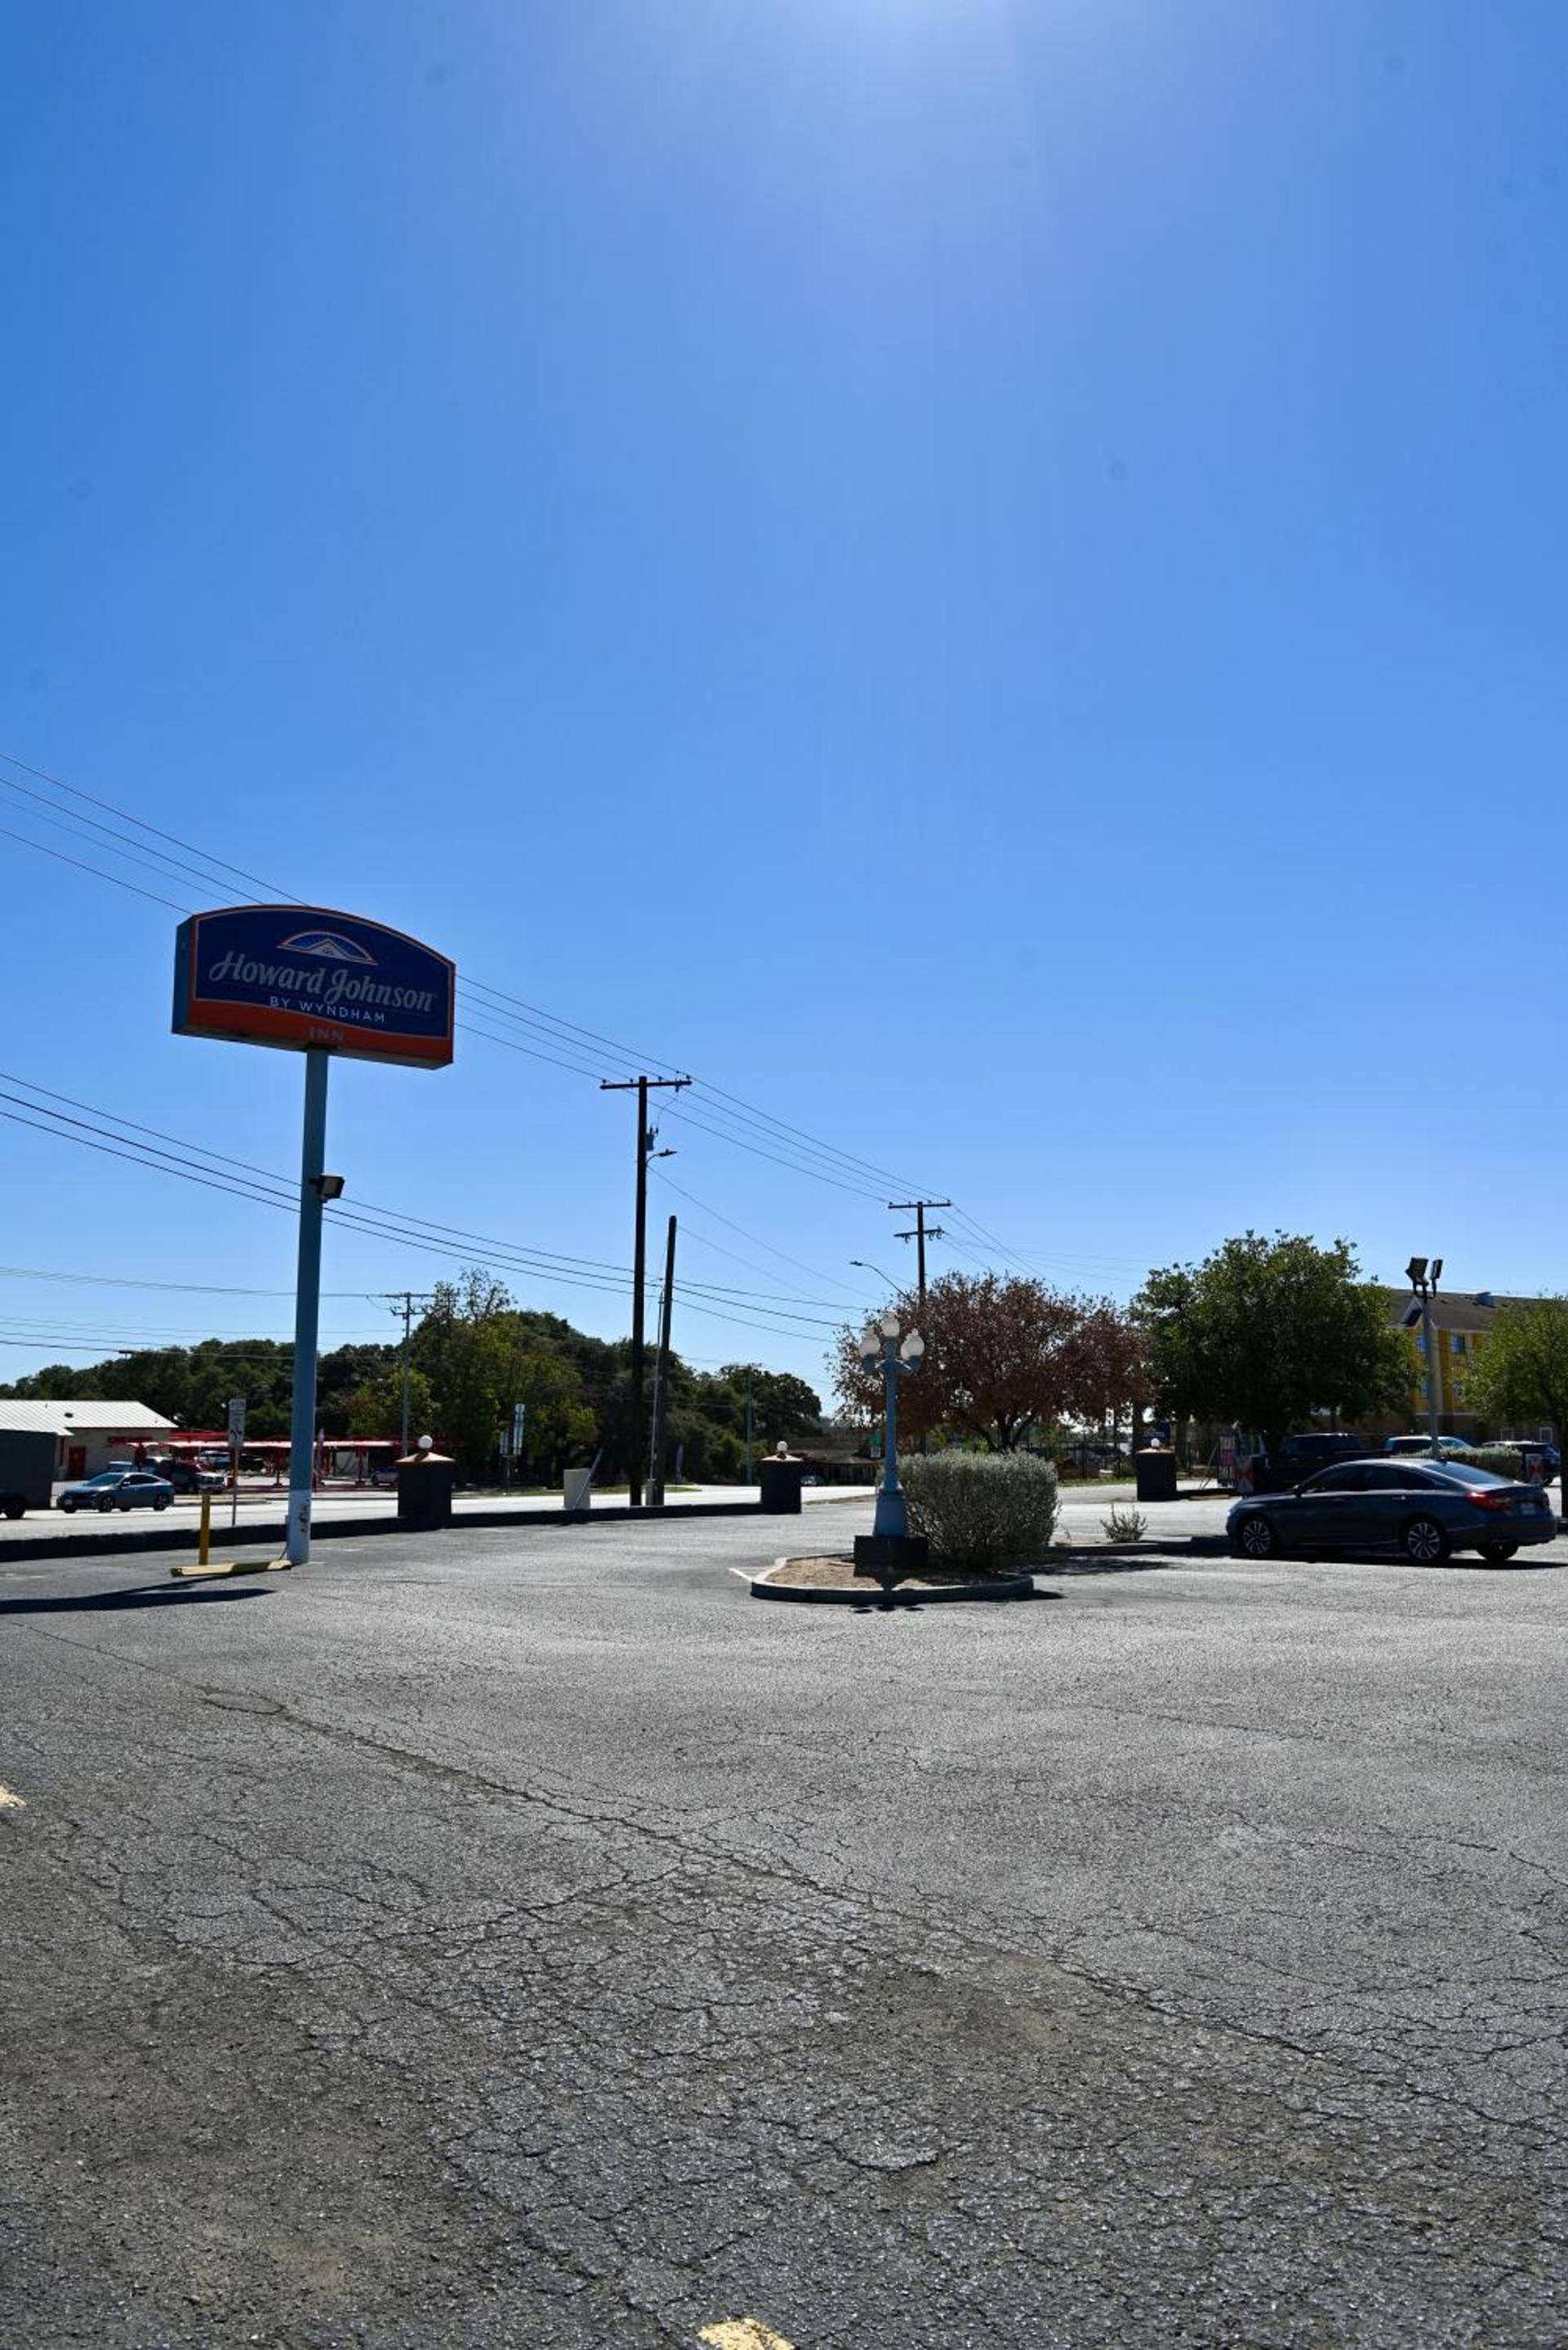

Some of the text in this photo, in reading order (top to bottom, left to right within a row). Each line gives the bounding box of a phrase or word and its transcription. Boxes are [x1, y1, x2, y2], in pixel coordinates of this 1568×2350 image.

[209, 950, 433, 1012] Howard Johnson
[270, 996, 385, 1023] BY WYNDHAM
